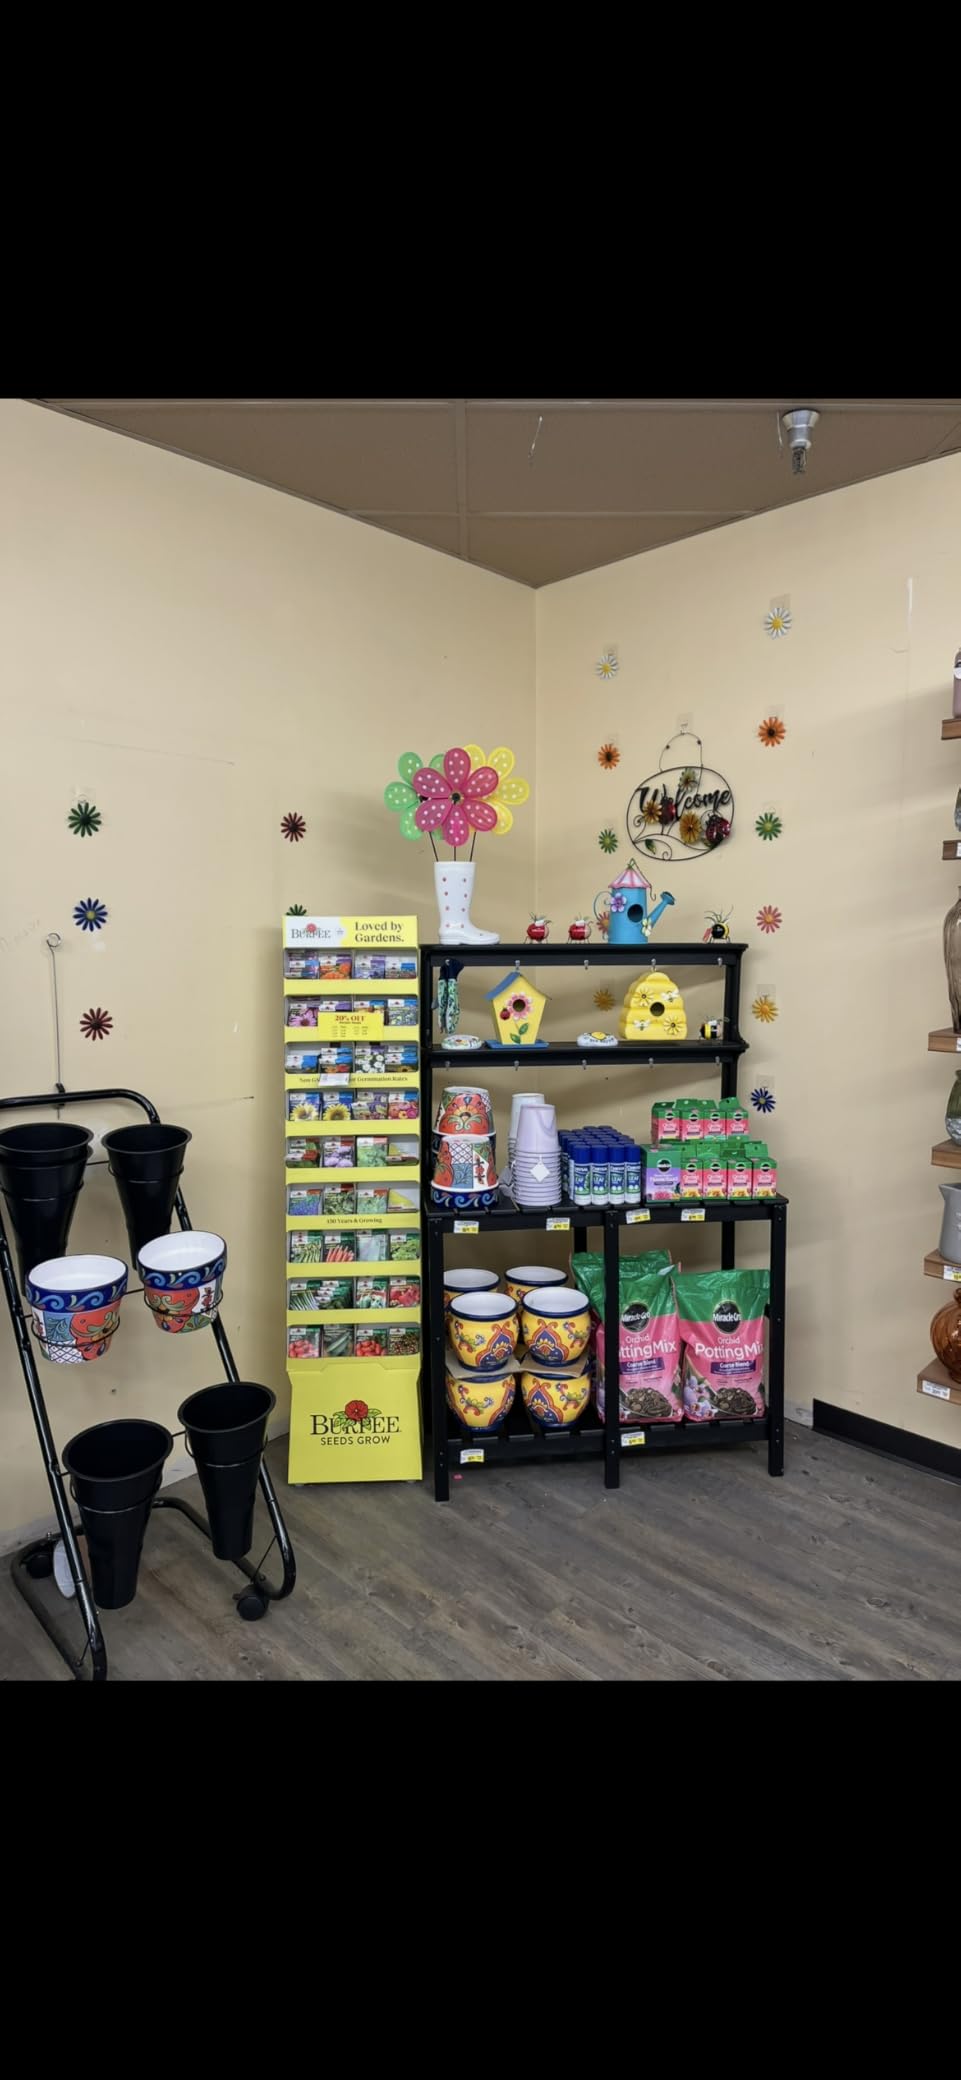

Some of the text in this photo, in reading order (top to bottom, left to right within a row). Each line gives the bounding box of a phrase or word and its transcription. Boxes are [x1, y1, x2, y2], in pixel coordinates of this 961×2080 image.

[355, 921, 404, 932] Loved by
[354, 933, 405, 942] Gardens.
[625, 1335, 649, 1344] Orchid
[717, 1337, 741, 1345] Orchid
[619, 1340, 677, 1359] tting Mix
[695, 1344, 744, 1360] Potting
[310, 1414, 402, 1435] BURPEE
[321, 1435, 391, 1446] SEEDS GROW
